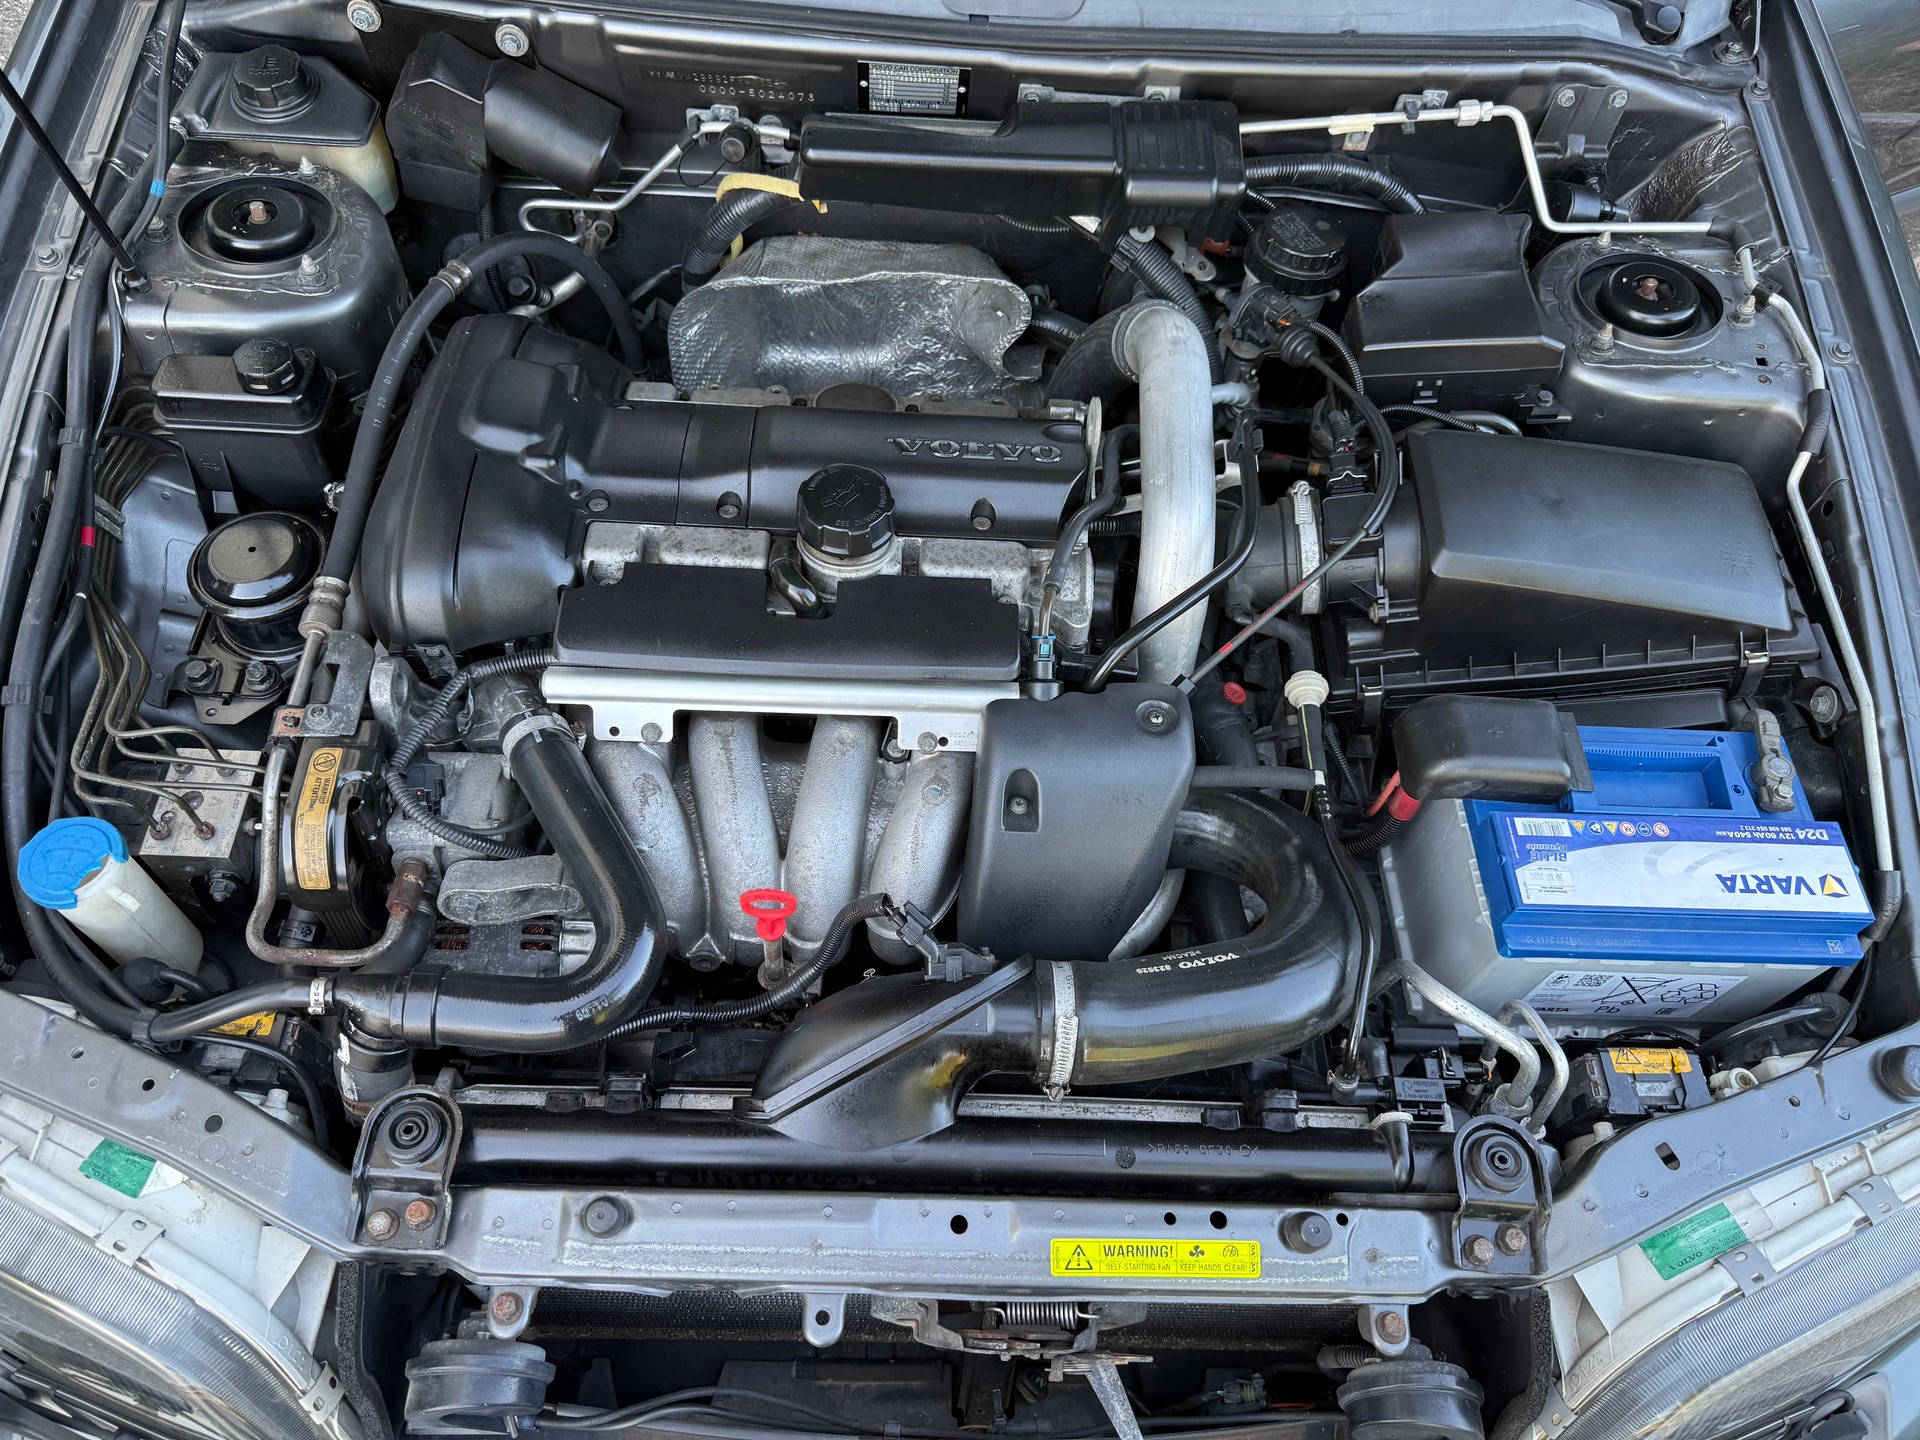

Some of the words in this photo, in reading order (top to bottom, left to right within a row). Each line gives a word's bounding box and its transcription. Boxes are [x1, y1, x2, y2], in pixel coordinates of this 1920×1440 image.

[377, 396, 386, 408] 23
[887, 437, 1062, 463] VOLVO
[1779, 832, 1796, 840] 12V
[1795, 827, 1829, 840] D24
[1526, 843, 1568, 852] Dynamic
[1529, 851, 1567, 861] BLUE
[1715, 873, 1817, 896] VARTA
[1178, 952, 1240, 969] VOLVO
[1594, 1005, 1620, 1014] Pb
[1102, 1244, 1174, 1259] WARNING!
[1668, 1250, 1703, 1270] VOLVO
[1106, 1263, 1156, 1271] SELF-STARTING
[1157, 1264, 1171, 1272] FAN
[1180, 1264, 1198, 1272] KEEP
[1198, 1264, 1222, 1272] HANDS
[1224, 1264, 1248, 1272] CLEAR!
